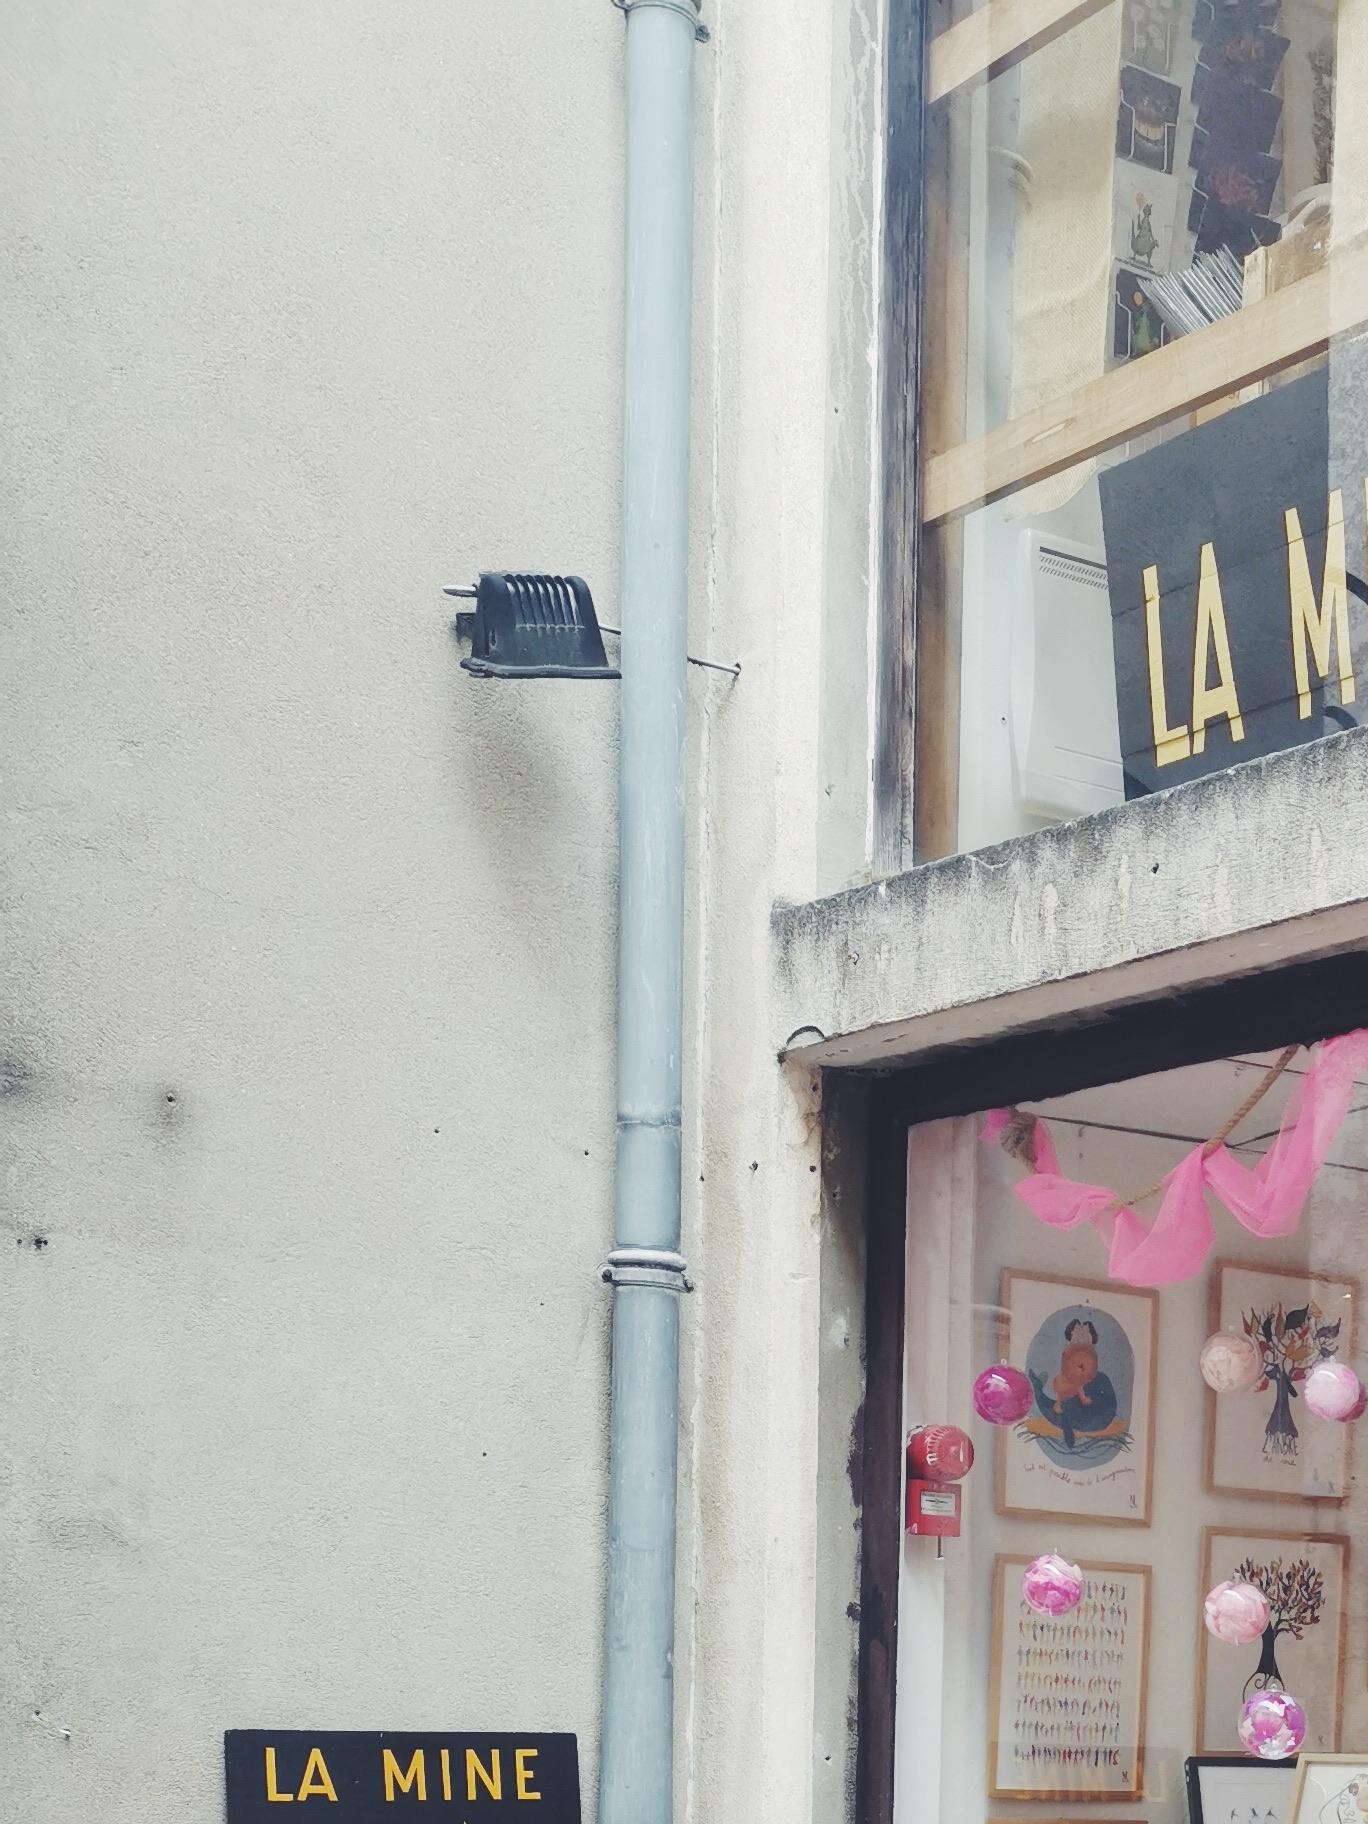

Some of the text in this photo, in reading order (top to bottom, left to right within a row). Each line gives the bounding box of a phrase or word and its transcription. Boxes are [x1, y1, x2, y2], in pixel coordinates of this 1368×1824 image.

[1142, 541, 1247, 768] LA
[265, 1747, 338, 1802] LA
[383, 1748, 541, 1801] MINE
